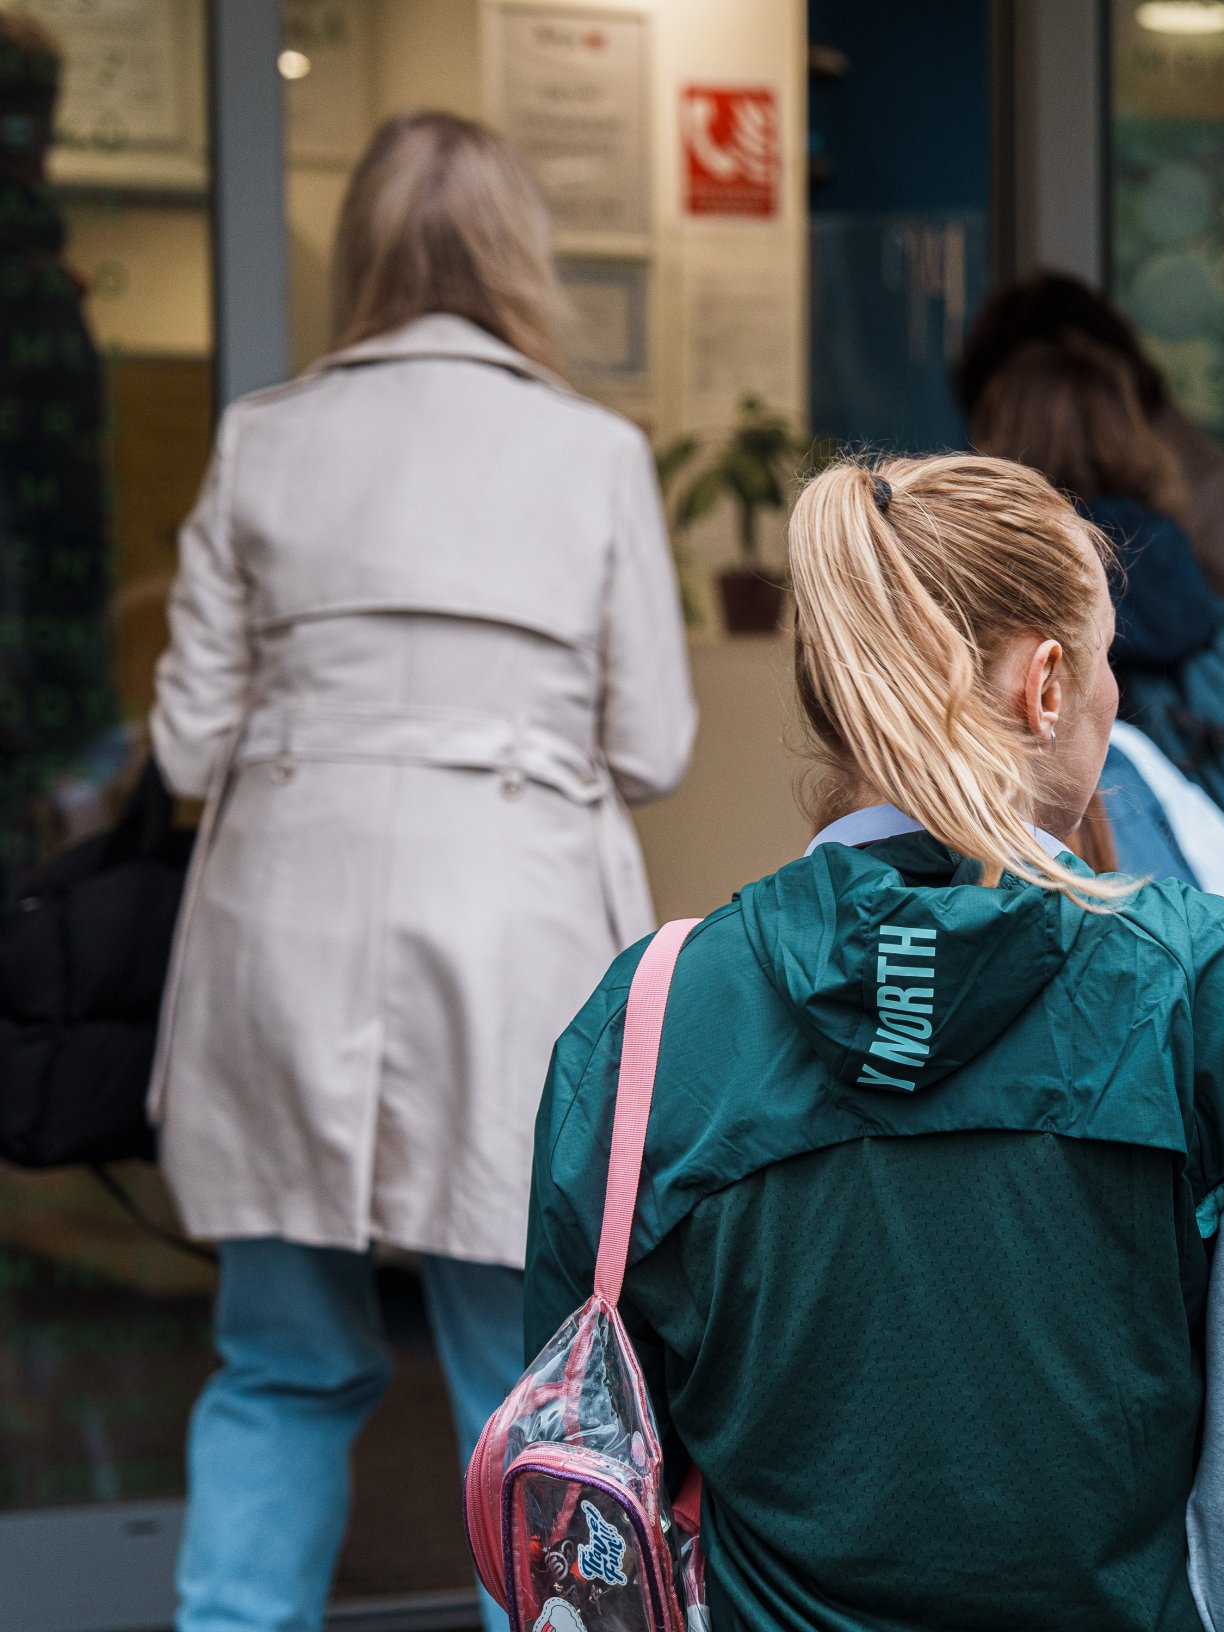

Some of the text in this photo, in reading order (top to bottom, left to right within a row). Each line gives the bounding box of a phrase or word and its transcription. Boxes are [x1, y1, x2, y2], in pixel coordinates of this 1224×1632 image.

[869, 925, 937, 1067] NORTH
[581, 1506, 608, 1576] Travel
[599, 1521, 624, 1582] Fun!!!
